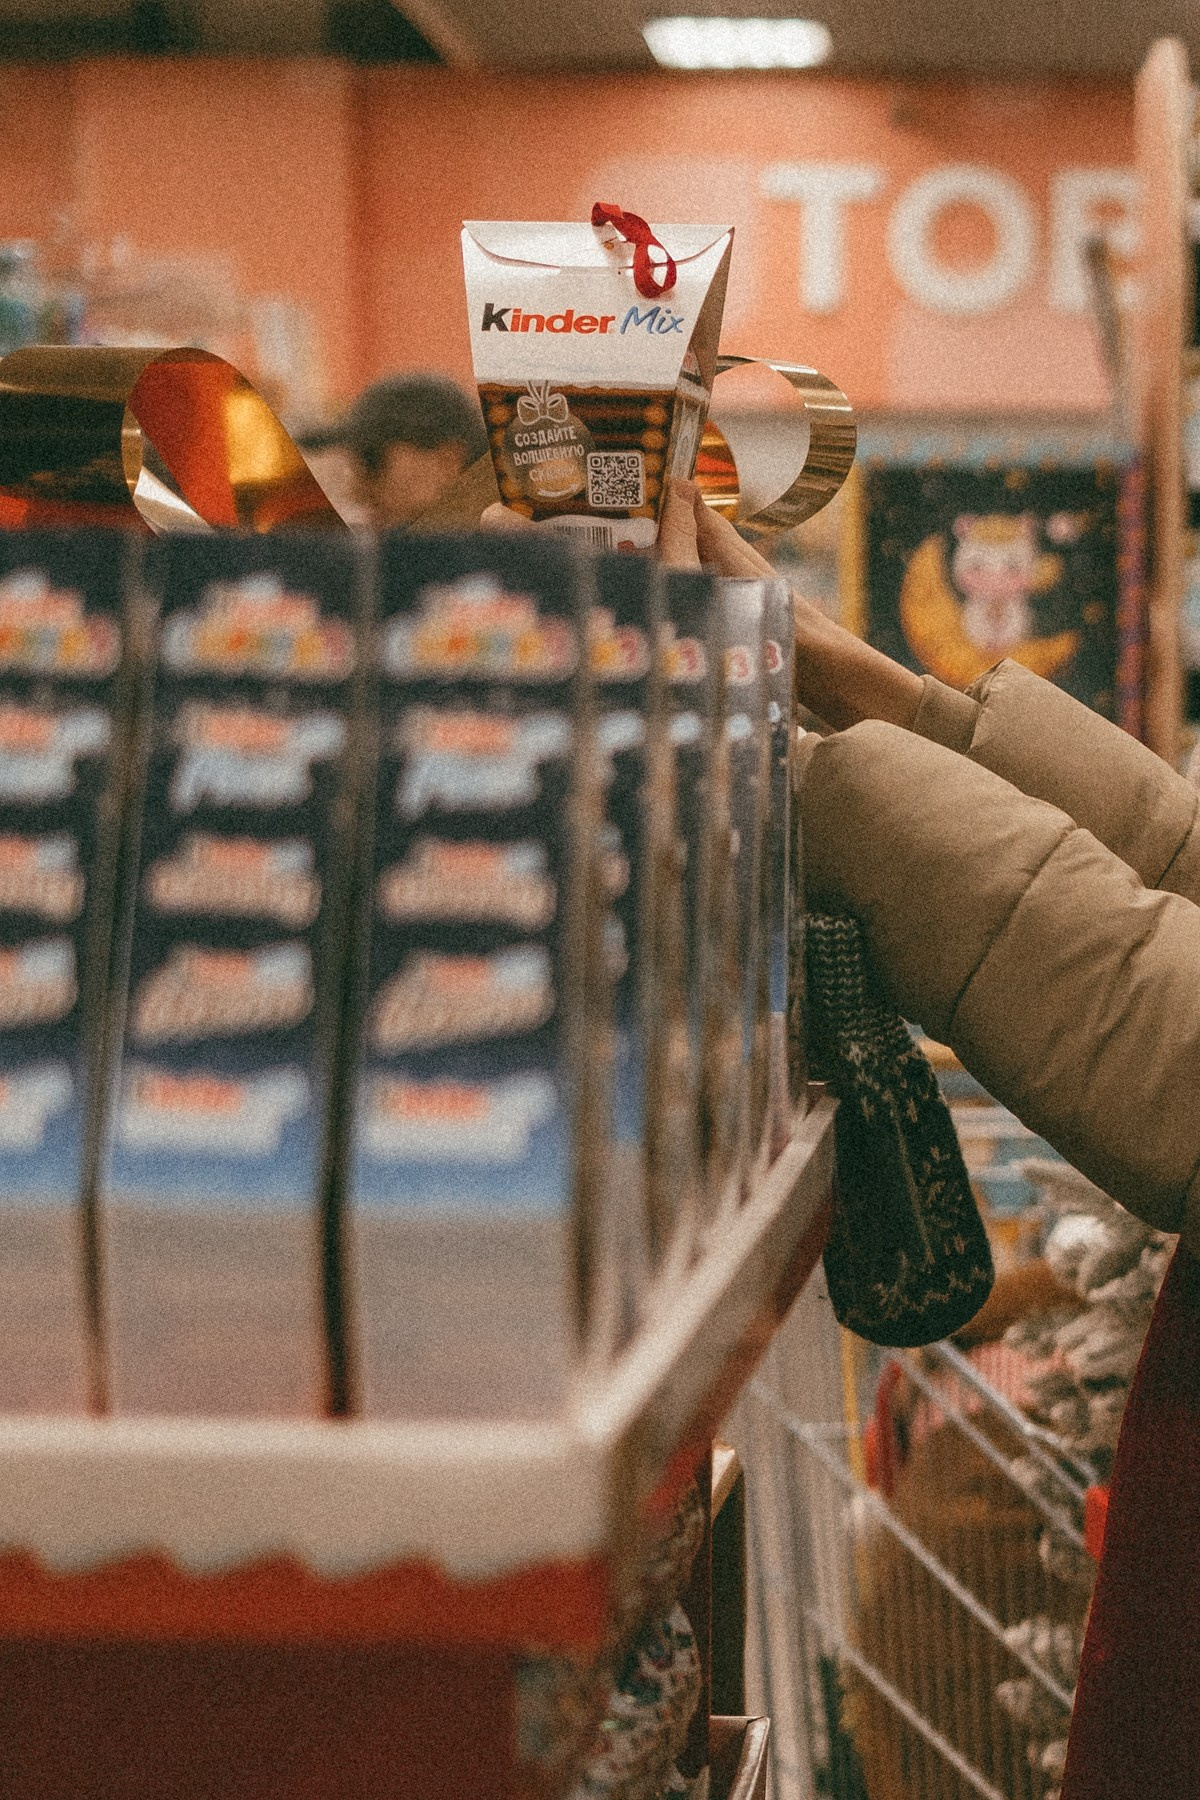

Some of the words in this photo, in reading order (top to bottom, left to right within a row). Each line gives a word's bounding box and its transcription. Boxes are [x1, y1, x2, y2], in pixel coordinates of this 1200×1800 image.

[481, 302, 616, 334] Kinder
[619, 305, 686, 335] Mix
[514, 424, 578, 447] СОЗДАЙТЕ
[512, 444, 585, 466] ВОЛШЕБНУЮ
